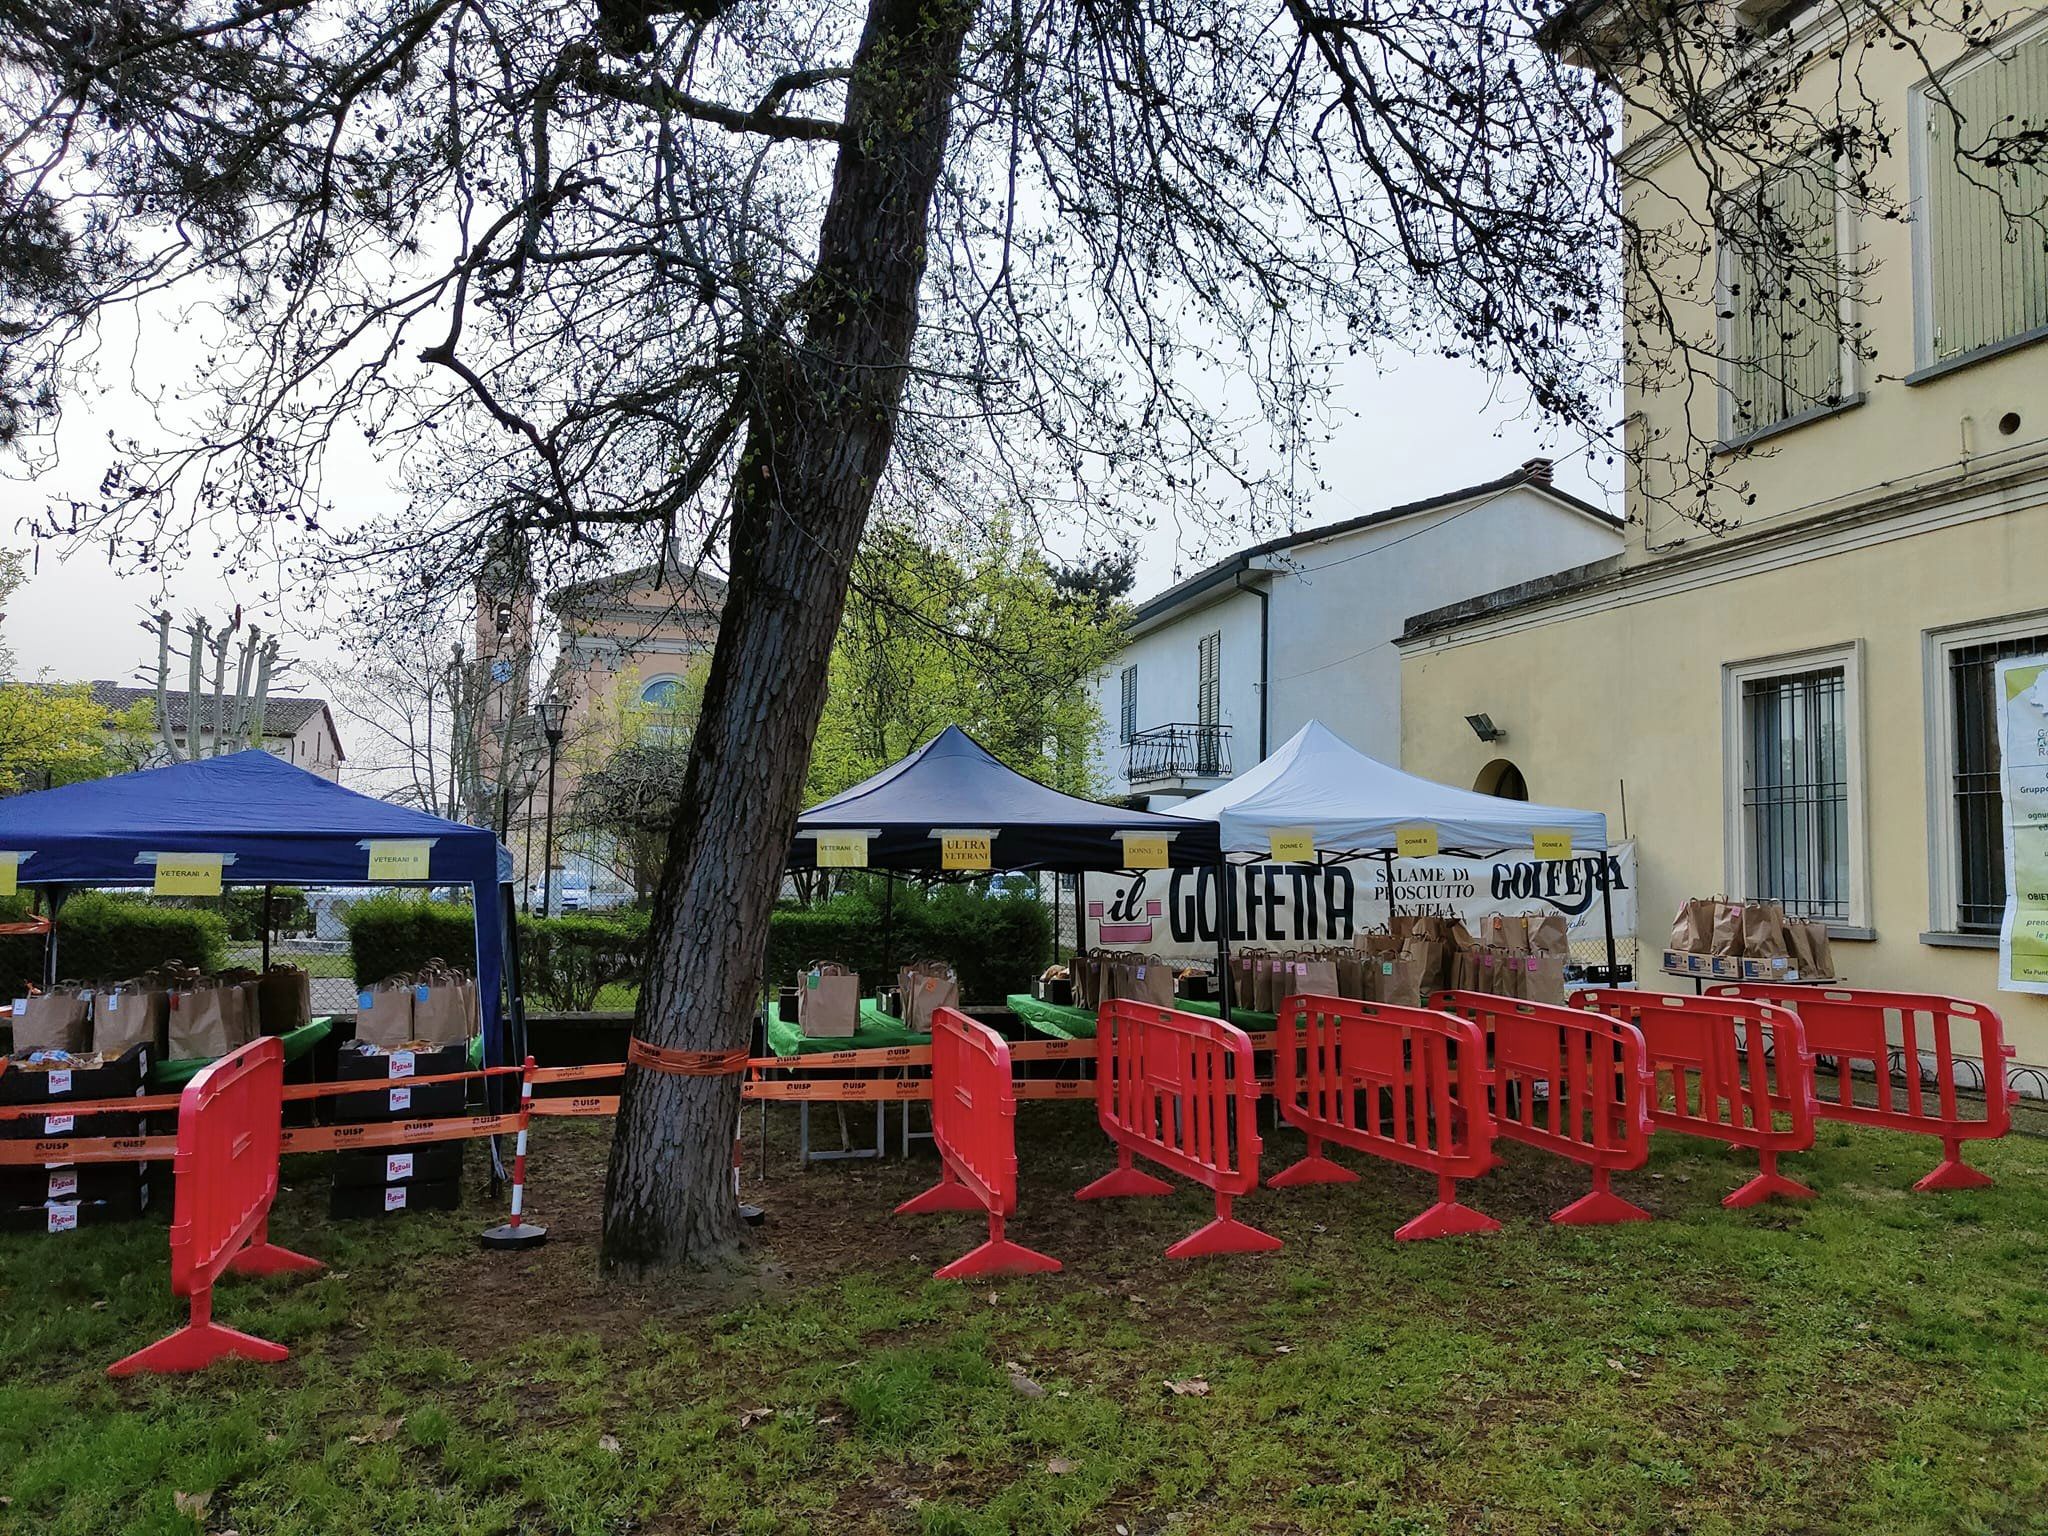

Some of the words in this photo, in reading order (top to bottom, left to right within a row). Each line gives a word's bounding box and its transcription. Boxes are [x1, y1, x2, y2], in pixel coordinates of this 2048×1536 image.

[2027, 812, 2048, 820] ognu
[947, 840, 986, 850] ULTRA
[945, 852, 988, 860] VETERANI
[1376, 868, 1445, 883] SALAME
[1452, 868, 1469, 881] DI
[1491, 855, 1629, 915] GOLFERA
[1107, 875, 1146, 922] il
[1169, 864, 1354, 942] GOLFETTA
[894, 1048, 911, 1056] UISP
[391, 1060, 413, 1071] Pizzoli
[343, 1128, 364, 1136] UISP
[45, 1142, 69, 1150] UISP
[122, 1140, 146, 1148] UISP
[389, 1161, 411, 1173] Pizzoli
[51, 1177, 75, 1189] Pizzoli
[51, 1213, 75, 1226] Pizzoli
